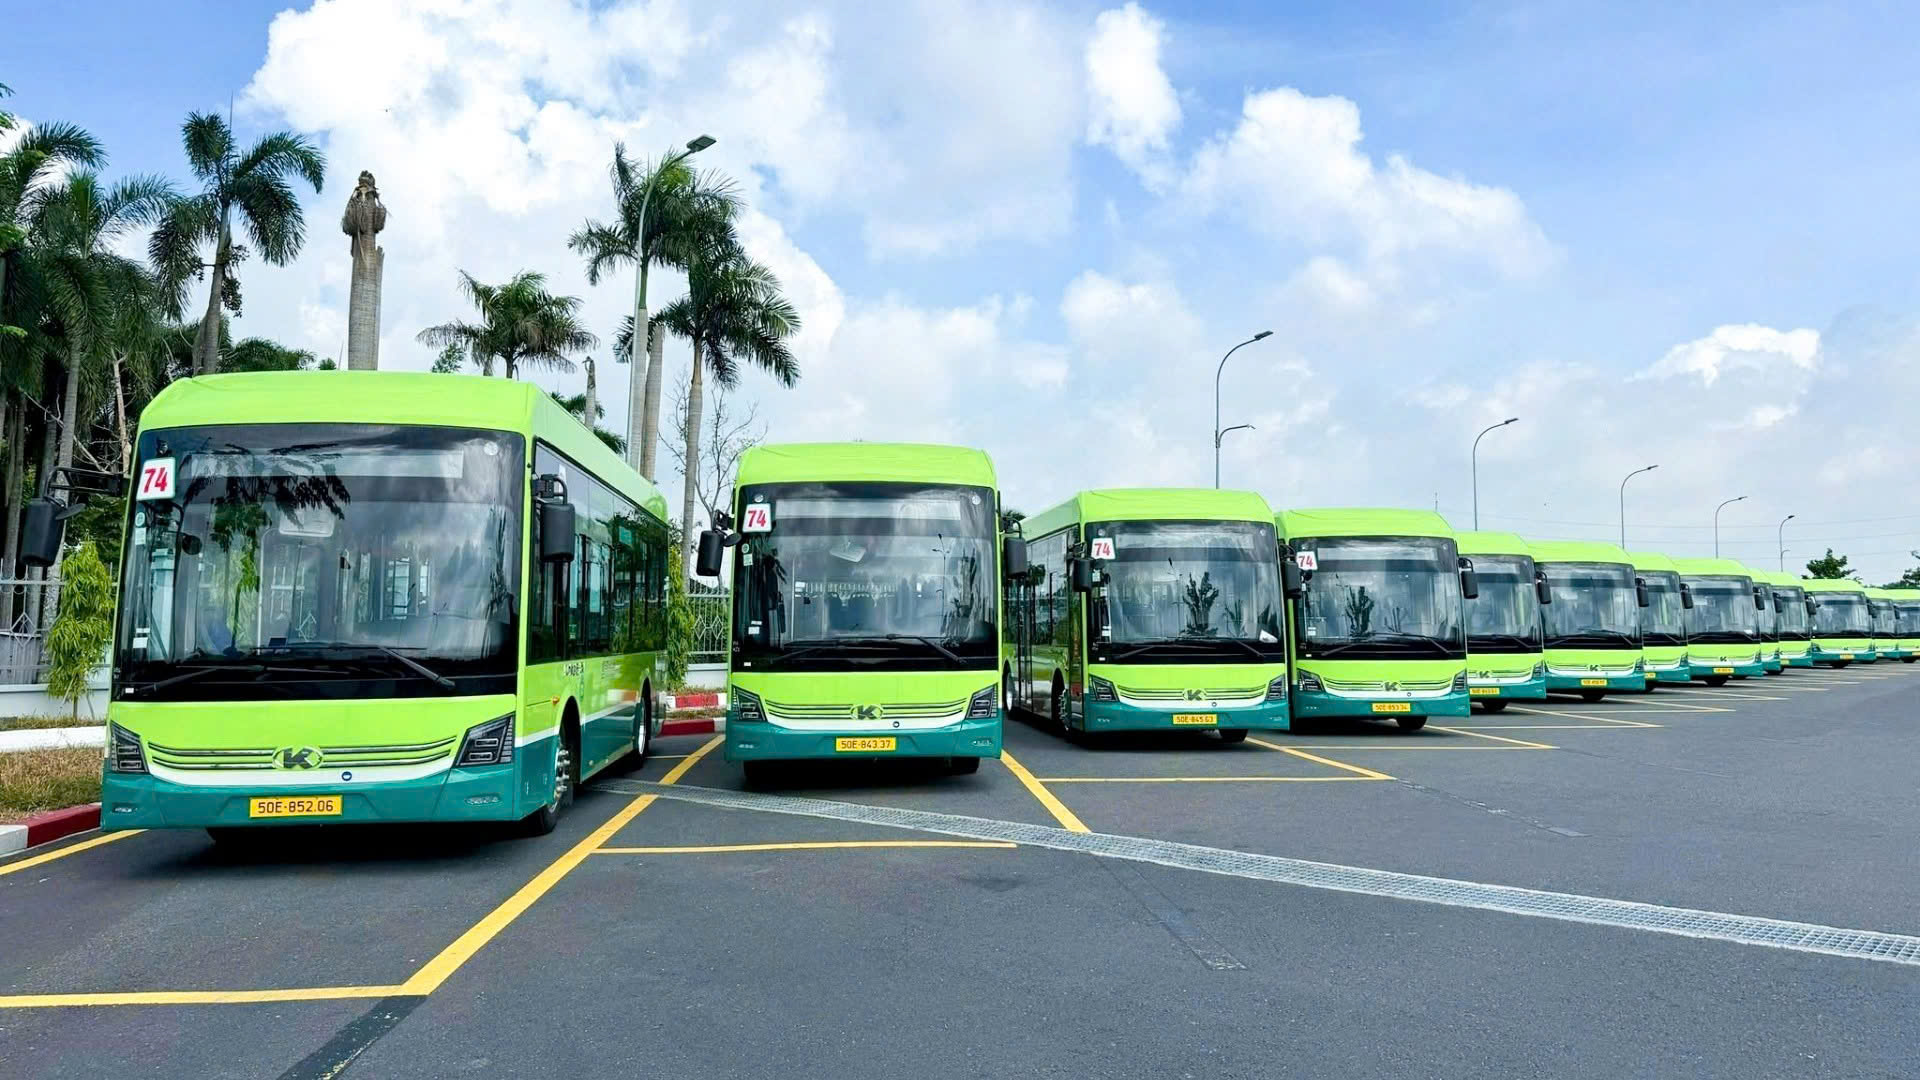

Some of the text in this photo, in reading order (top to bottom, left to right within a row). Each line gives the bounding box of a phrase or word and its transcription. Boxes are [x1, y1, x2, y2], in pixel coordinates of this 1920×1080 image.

[143, 467, 168, 493] 74
[747, 510, 766, 527] 74
[1094, 543, 1111, 556] 74
[1298, 555, 1313, 568] 74
[257, 799, 334, 814] 50E-852.06
